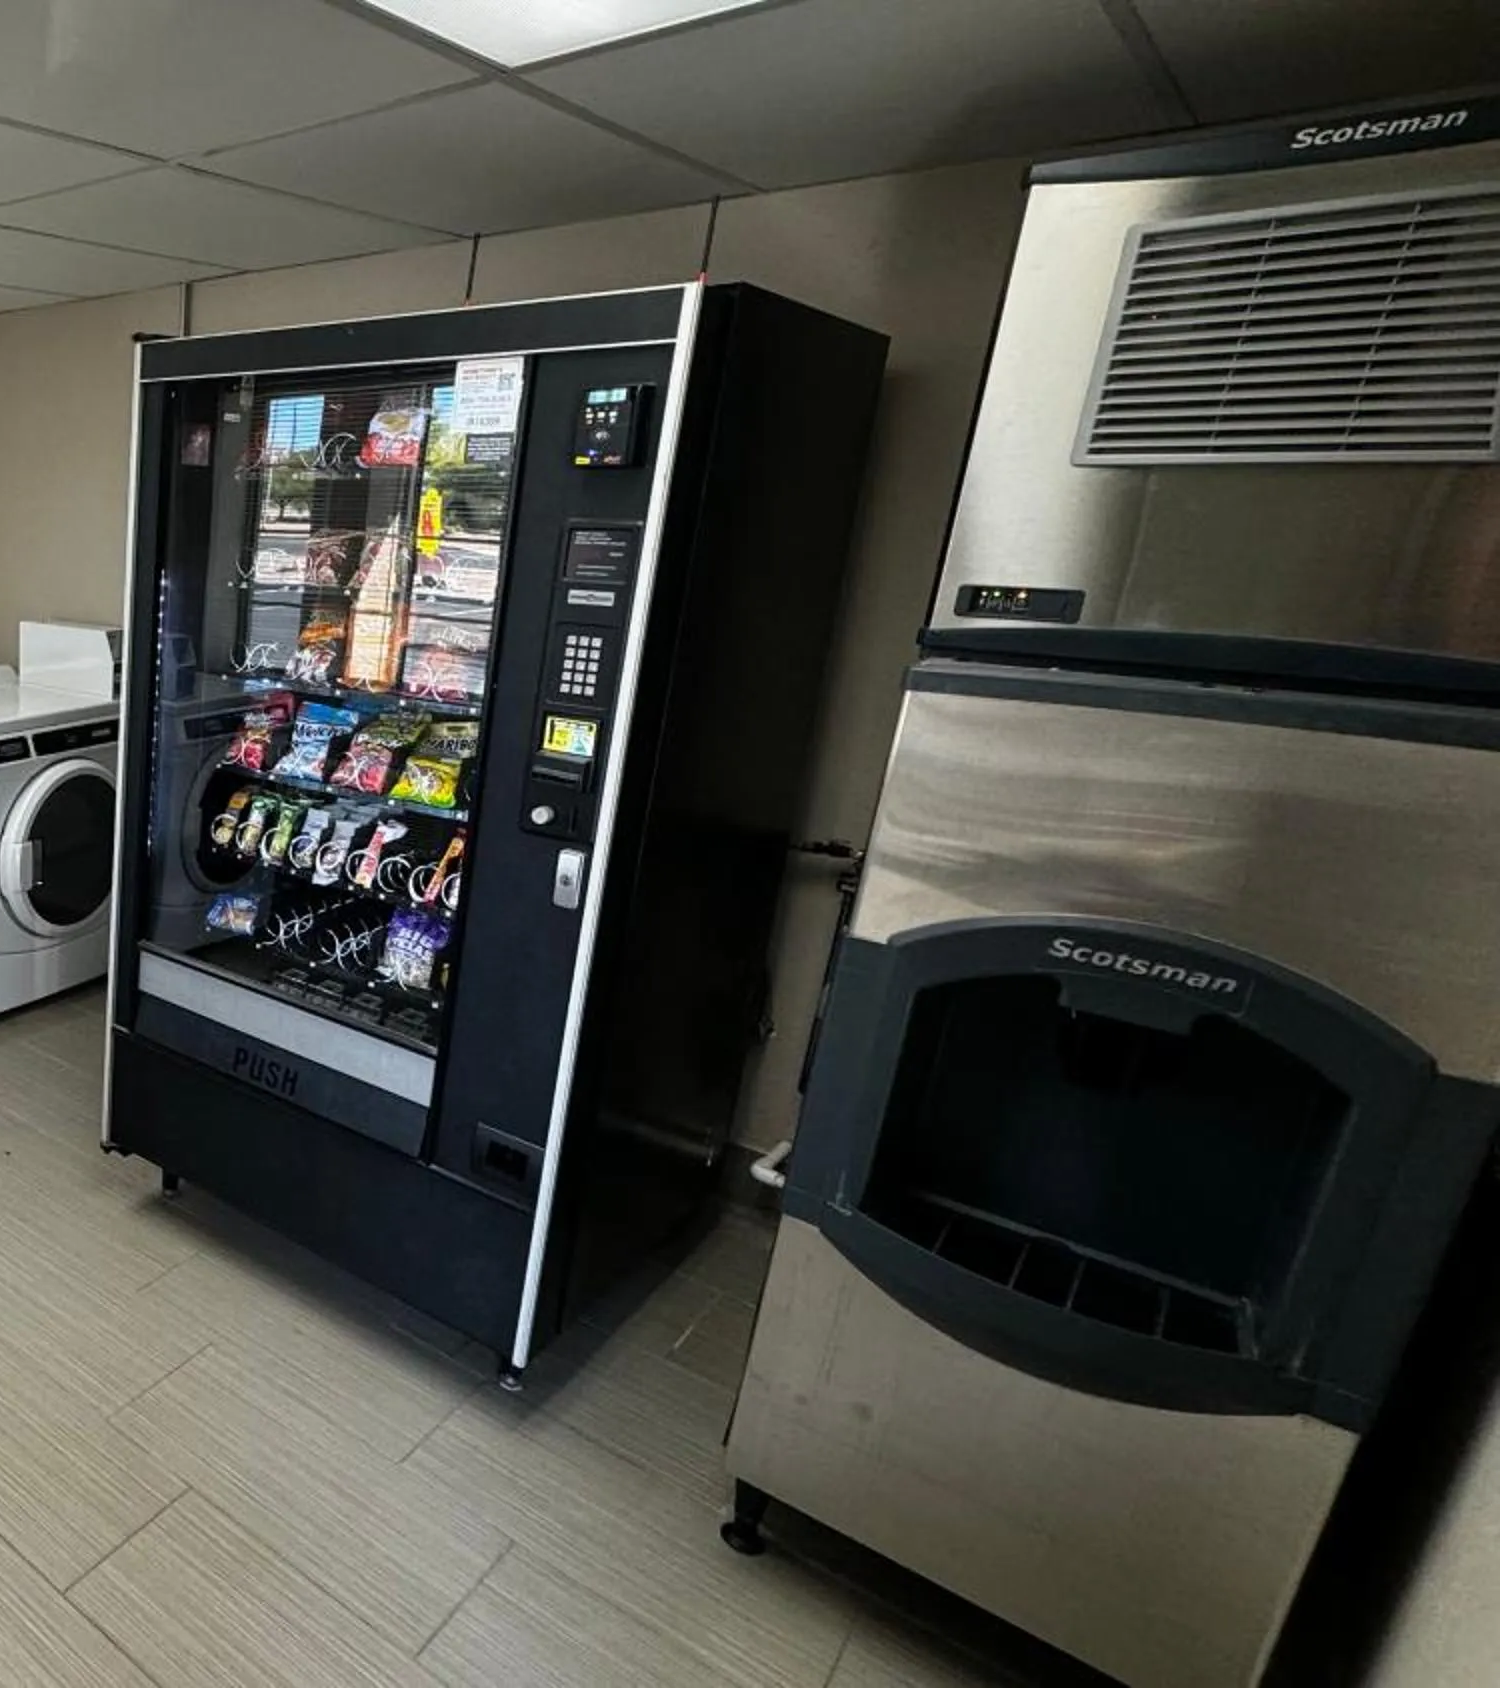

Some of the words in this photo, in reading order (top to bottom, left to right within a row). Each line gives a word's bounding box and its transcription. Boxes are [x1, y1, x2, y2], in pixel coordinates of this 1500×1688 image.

[1290, 109, 1470, 150] Scotsman
[1049, 937, 1238, 993] Scotsman
[232, 1046, 299, 1096] PUSH
